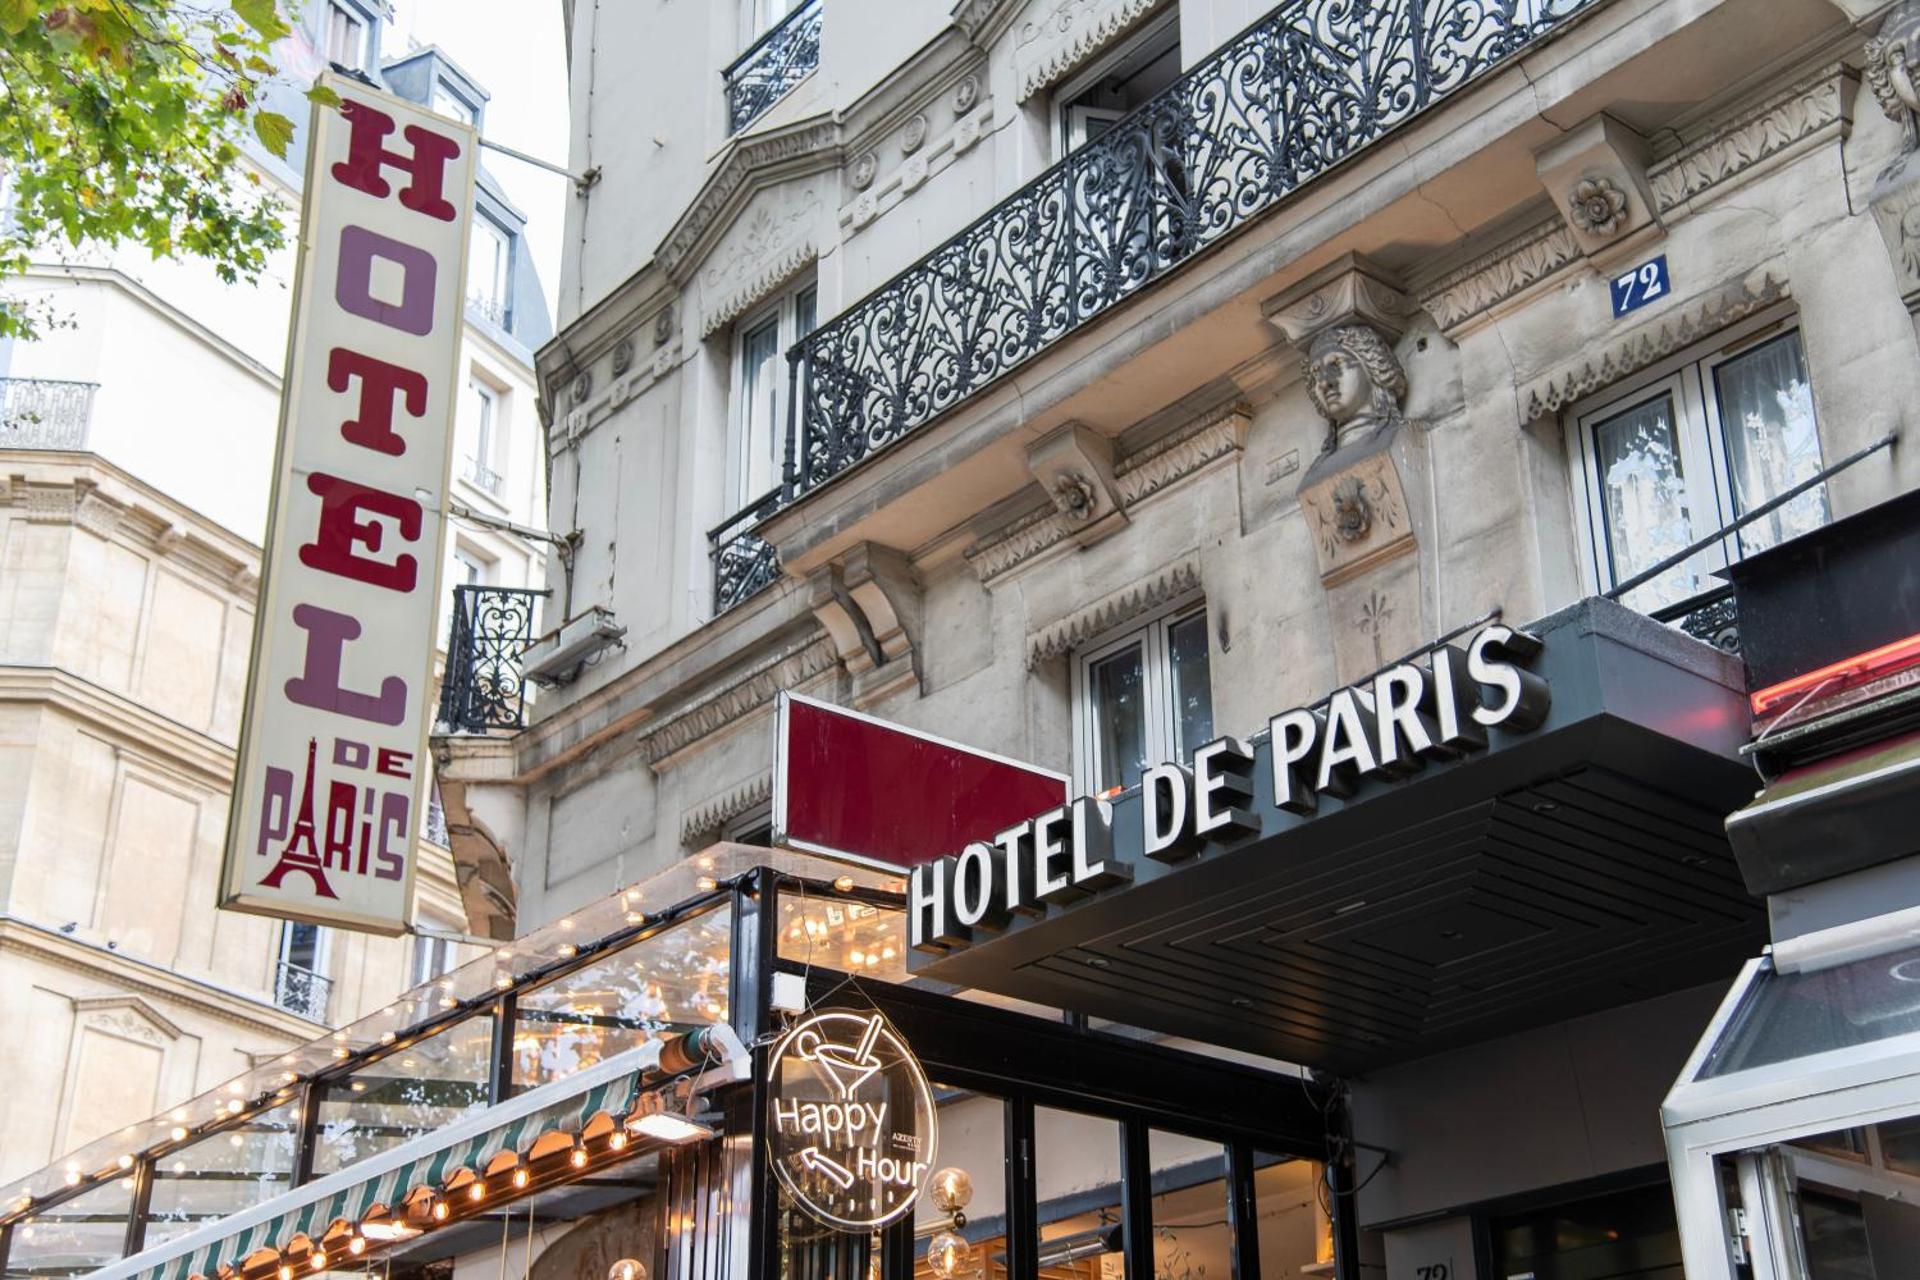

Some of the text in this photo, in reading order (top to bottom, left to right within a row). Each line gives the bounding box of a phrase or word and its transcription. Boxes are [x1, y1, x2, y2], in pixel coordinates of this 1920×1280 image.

[1617, 262, 1662, 311] 72
[284, 98, 461, 726] HOTEL
[332, 737, 413, 780] DE
[911, 624, 1523, 948] HOTEL DE PARIS
[775, 1097, 888, 1149] Happy
[858, 1147, 928, 1187] Hour
